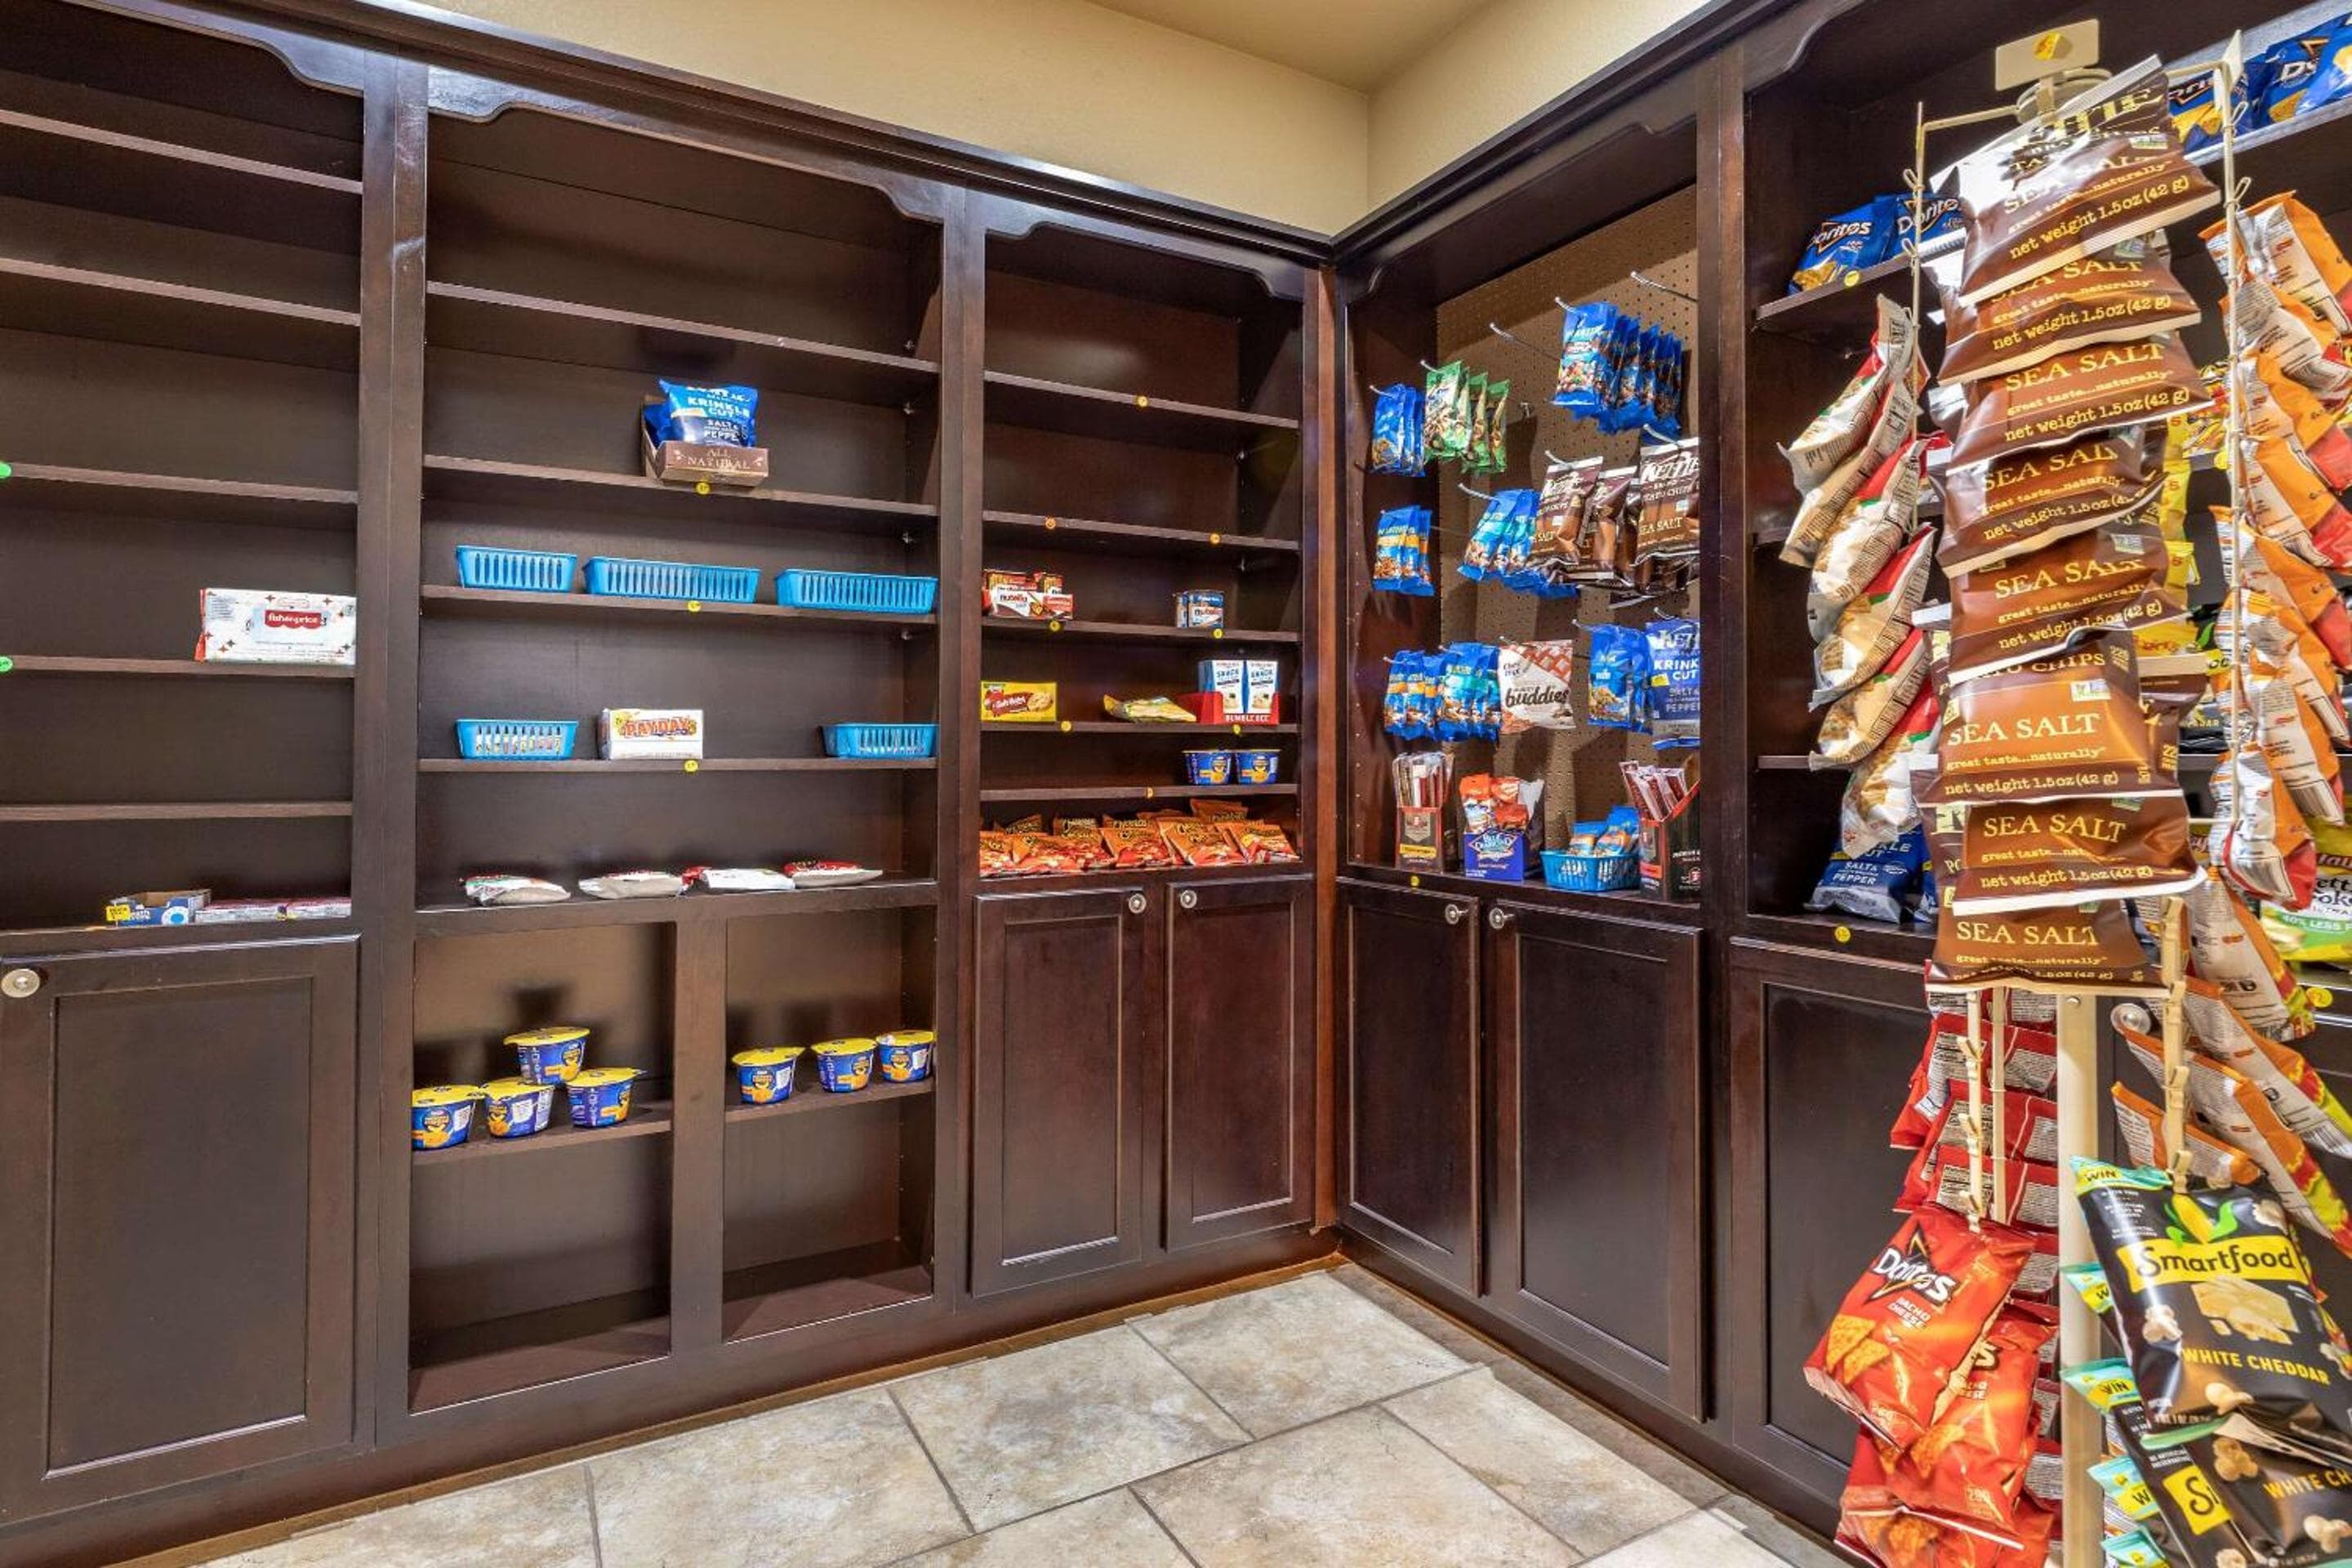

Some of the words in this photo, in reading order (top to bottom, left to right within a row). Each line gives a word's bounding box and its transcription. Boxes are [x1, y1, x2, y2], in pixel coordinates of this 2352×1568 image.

[2009, 238, 2040, 261] net
[2041, 212, 2098, 247] weight
[1992, 333, 2021, 351] net
[2024, 314, 2079, 342] weight
[2005, 363, 2071, 393] SEA
[2079, 342, 2164, 374] SALT
[688, 396, 751, 418] KRINKLE
[708, 407, 734, 418] CUT
[703, 429, 739, 442] PEPPE
[2005, 424, 2035, 443] net
[2035, 408, 2097, 433] weight
[688, 457, 751, 470] NATURAL
[1983, 461, 2041, 492] SEA
[1984, 523, 2011, 541] net
[2014, 505, 2067, 531] weight
[1994, 568, 2058, 599] SEA
[1999, 634, 2027, 650] net
[2029, 616, 2080, 643] weight
[1653, 657, 1699, 671] KRINK
[1673, 670, 1697, 681] CUT
[1505, 686, 1570, 708] buddies
[1666, 703, 1700, 713] PEPPE
[1947, 719, 2009, 746] SEA
[2016, 712, 2101, 740] SALT
[1944, 782, 1972, 796] net
[1974, 777, 2031, 793] weight
[1983, 814, 2041, 838] SEA
[2048, 813, 2127, 844] SALT
[1832, 872, 1877, 885] PEPPER
[1980, 875, 2009, 889] net
[2009, 871, 2068, 888] weight
[1957, 921, 2016, 945] SEA
[2024, 925, 2100, 947] SALT
[2084, 1168, 2118, 1182] WIN
[1873, 1245, 1958, 1303] Doritos
[2137, 1244, 2296, 1279] Smartfood
[2181, 1347, 2243, 1369] WHITE
[2247, 1353, 2332, 1387] CHEDDAR
[2263, 1473, 2325, 1500] WHITE
